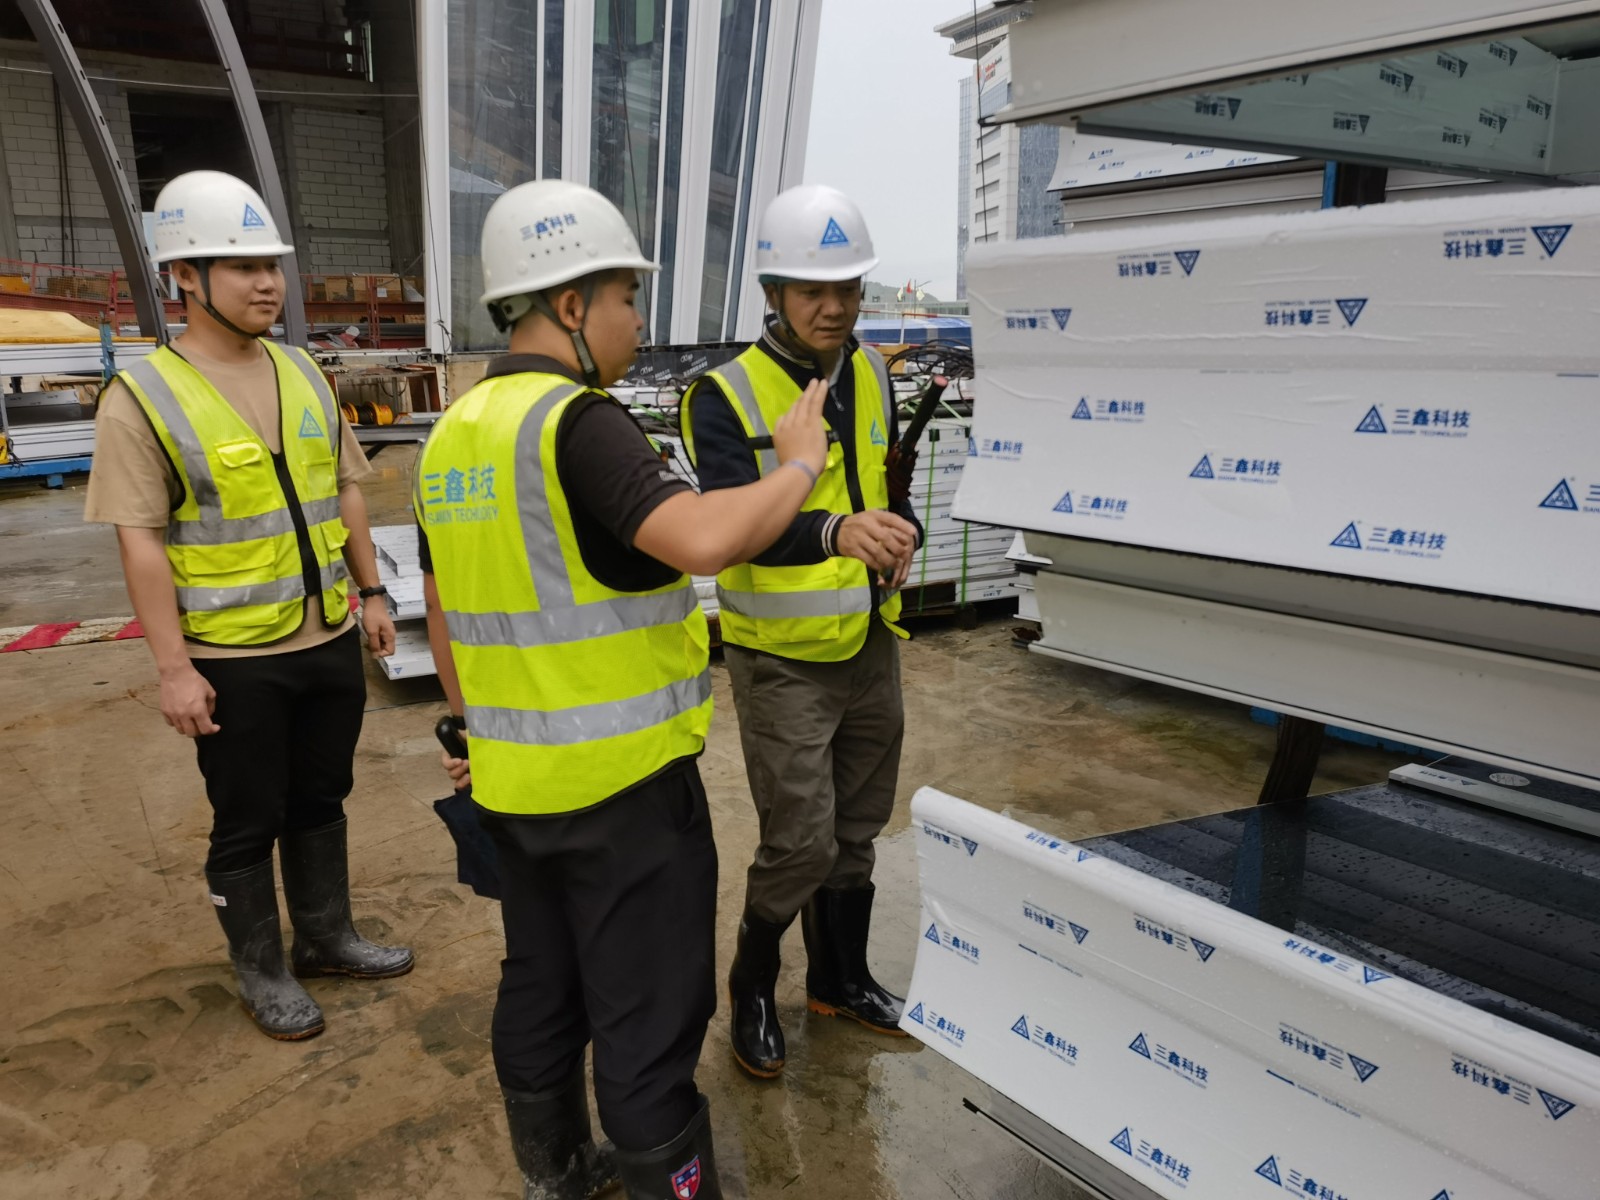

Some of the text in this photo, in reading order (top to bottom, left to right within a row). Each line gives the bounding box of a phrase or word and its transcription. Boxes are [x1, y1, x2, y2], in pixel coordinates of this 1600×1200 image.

[519, 213, 579, 241] 三鑫科技
[1443, 238, 1527, 259] 三鑫科技
[1117, 261, 1172, 277] 三鑫科技
[1264, 309, 1332, 326] 三鑫科技
[1094, 399, 1146, 416] 三鑫科技
[1393, 408, 1471, 429] 三鑫科技
[982, 438, 1024, 455] 三鑫科技
[1219, 457, 1283, 477] 三鑫科技
[1077, 495, 1128, 513] 三鑫科技
[1368, 527, 1447, 550] 三鑫科技
[1022, 906, 1066, 936] 三鑫科技
[1134, 919, 1189, 952] 三鑫科技
[942, 930, 980, 960] 三鑫科技
[1281, 938, 1356, 973] 三鑫科技
[927, 1010, 966, 1042] 三鑫科技
[1032, 1024, 1079, 1061] 三鑫科技
[1278, 1028, 1345, 1070] 三鑫科技
[1153, 1043, 1209, 1083] 三鑫科技
[1450, 1058, 1531, 1106] 三鑫科技
[1136, 1139, 1192, 1182] 三鑫科技
